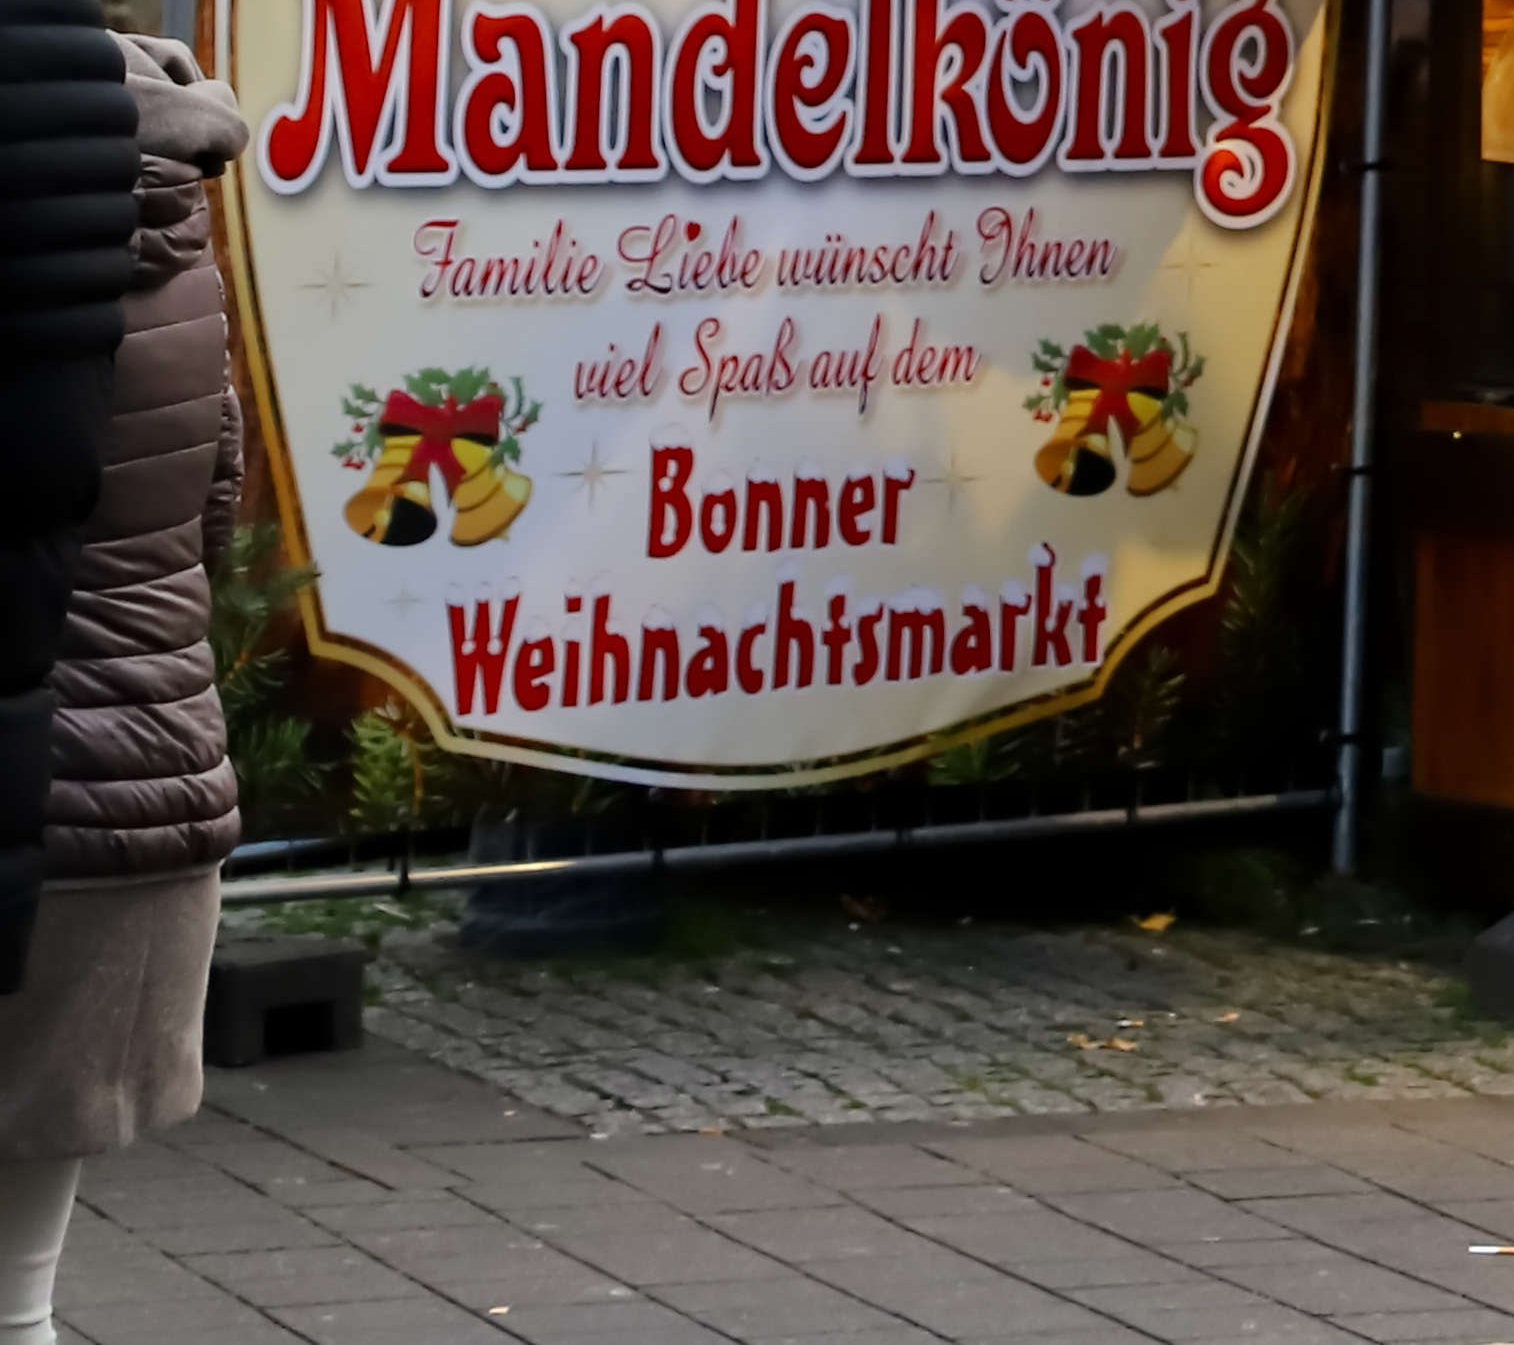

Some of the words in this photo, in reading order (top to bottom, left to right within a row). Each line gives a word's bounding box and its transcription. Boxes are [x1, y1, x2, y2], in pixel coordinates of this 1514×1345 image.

[414, 217, 600, 303] Familie
[618, 213, 763, 296] Liebe
[777, 211, 960, 289] wünscht
[977, 206, 1118, 286] Ihnen
[574, 324, 663, 402] viel
[692, 315, 800, 422] Spaß
[810, 321, 884, 414] auf
[892, 315, 983, 387] dem
[648, 434, 918, 559] Bonner
[446, 545, 1107, 716] Weihnachtsmarkt
